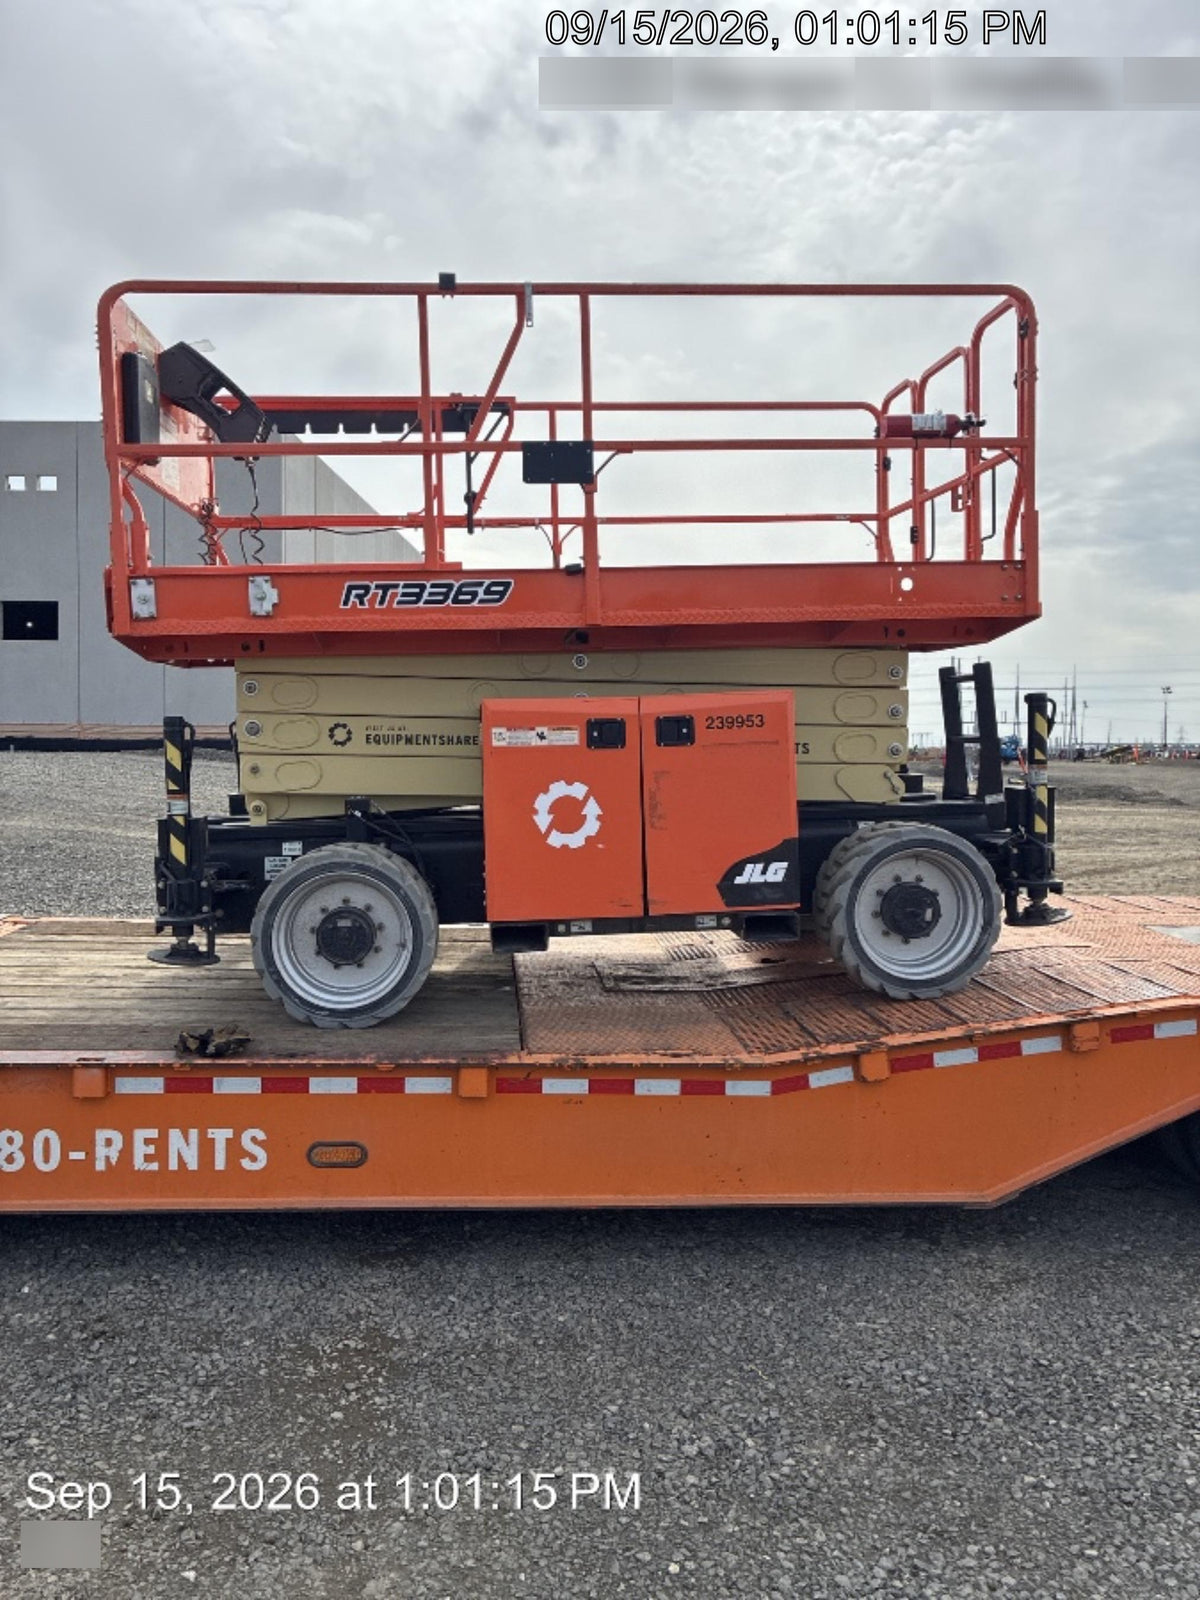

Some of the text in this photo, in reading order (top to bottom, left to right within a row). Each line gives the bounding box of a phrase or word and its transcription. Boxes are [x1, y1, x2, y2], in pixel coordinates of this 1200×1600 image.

[339, 579, 514, 609] RT3369
[705, 713, 765, 730] 239953
[365, 733, 479, 746] EQUIPMENTSHARE
[733, 861, 789, 885] JLG
